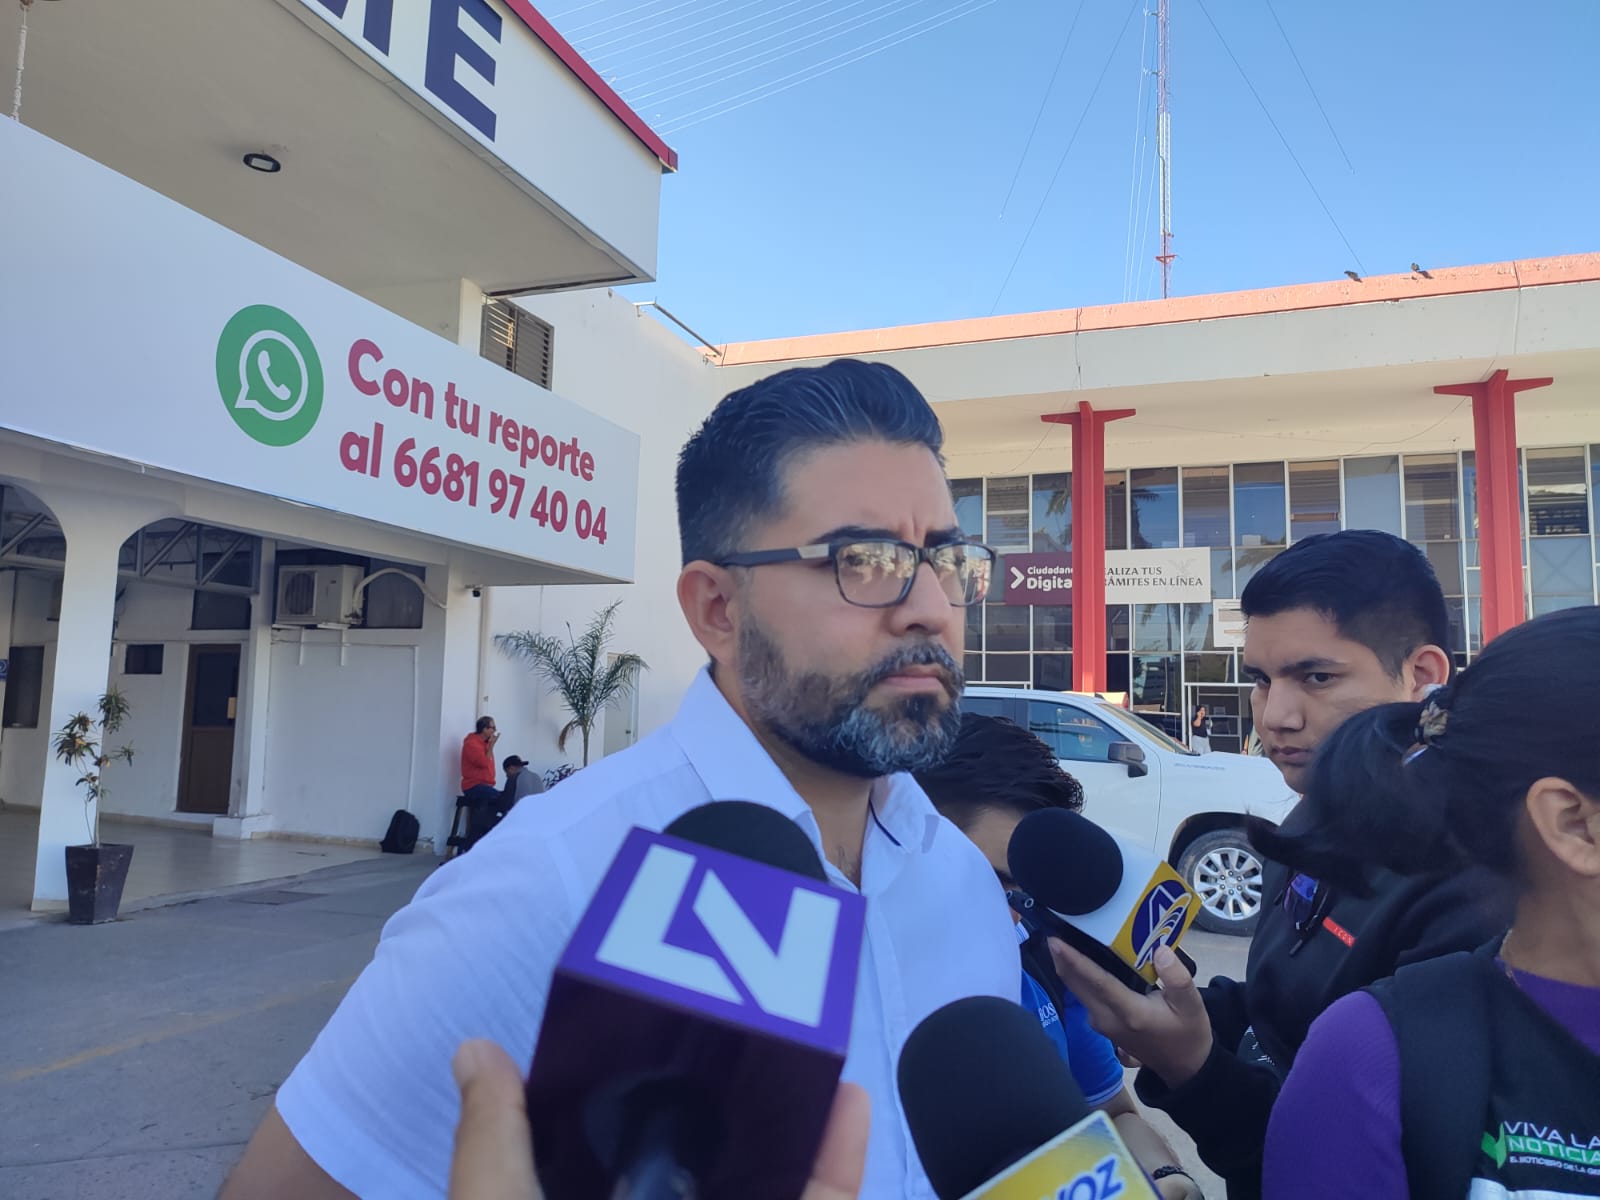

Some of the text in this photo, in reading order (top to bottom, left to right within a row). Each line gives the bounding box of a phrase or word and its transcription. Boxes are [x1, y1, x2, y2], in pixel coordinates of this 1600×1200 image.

[348, 338, 595, 482] Con tu reporte
[339, 421, 608, 545] al 6681 97 40 04
[1027, 566, 1073, 576] Ciudadan
[1104, 575, 1204, 587] ÁMITES EN LÍNEA
[1105, 566, 1162, 576] ALIZA TUS
[1026, 576, 1073, 592] Digita
[1503, 1120, 1600, 1150] VIVA LA
[1508, 1135, 1600, 1164] NOTICIA
